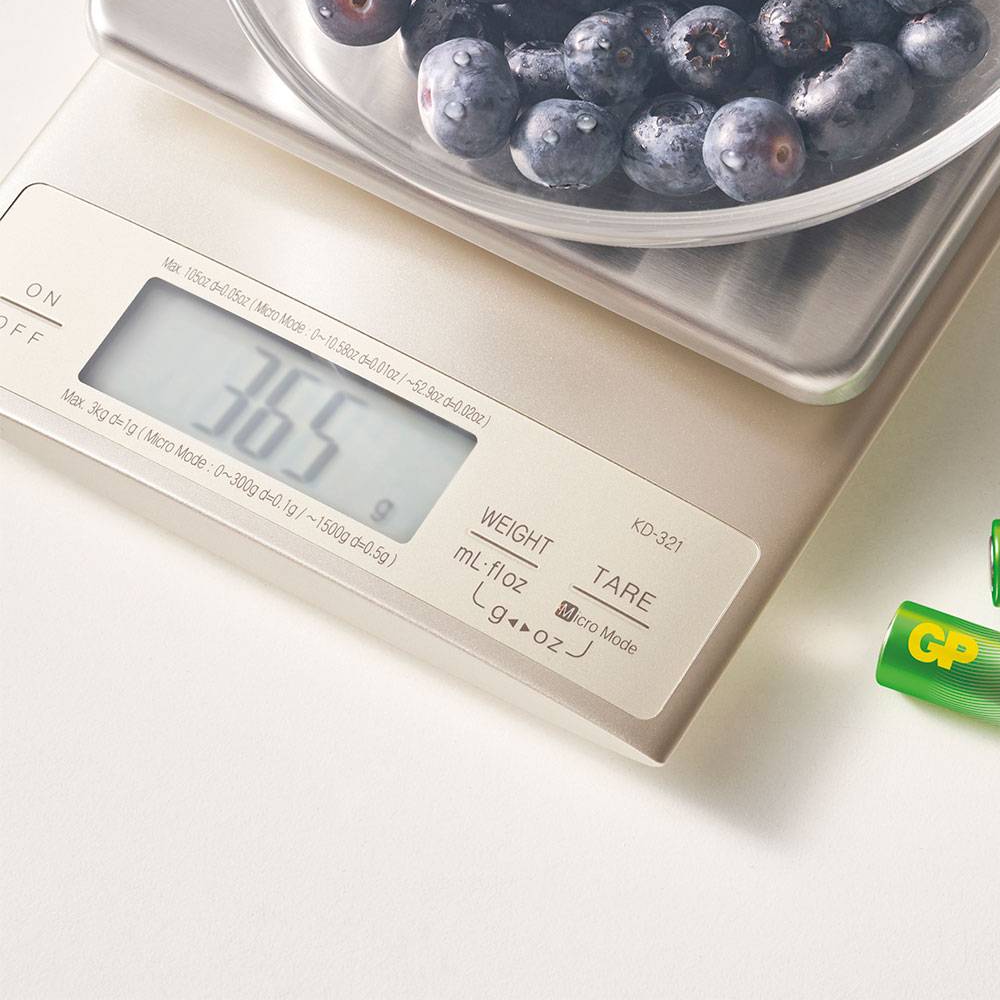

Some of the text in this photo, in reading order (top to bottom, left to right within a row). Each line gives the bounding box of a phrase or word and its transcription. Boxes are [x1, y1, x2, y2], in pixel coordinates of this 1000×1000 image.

[26, 282, 62, 307] ON
[255, 300, 280, 322] Micro
[60, 388, 85, 410] Max.
[86, 400, 110, 422] 3kg
[108, 411, 139, 436] d=1g
[143, 429, 176, 453] Micro
[191, 345, 369, 484] 365
[480, 505, 555, 556] WEIGHT
[630, 517, 684, 554] KD-321
[592, 564, 657, 613] TARE
[554, 599, 599, 634] Micro
[907, 621, 979, 671] GP
